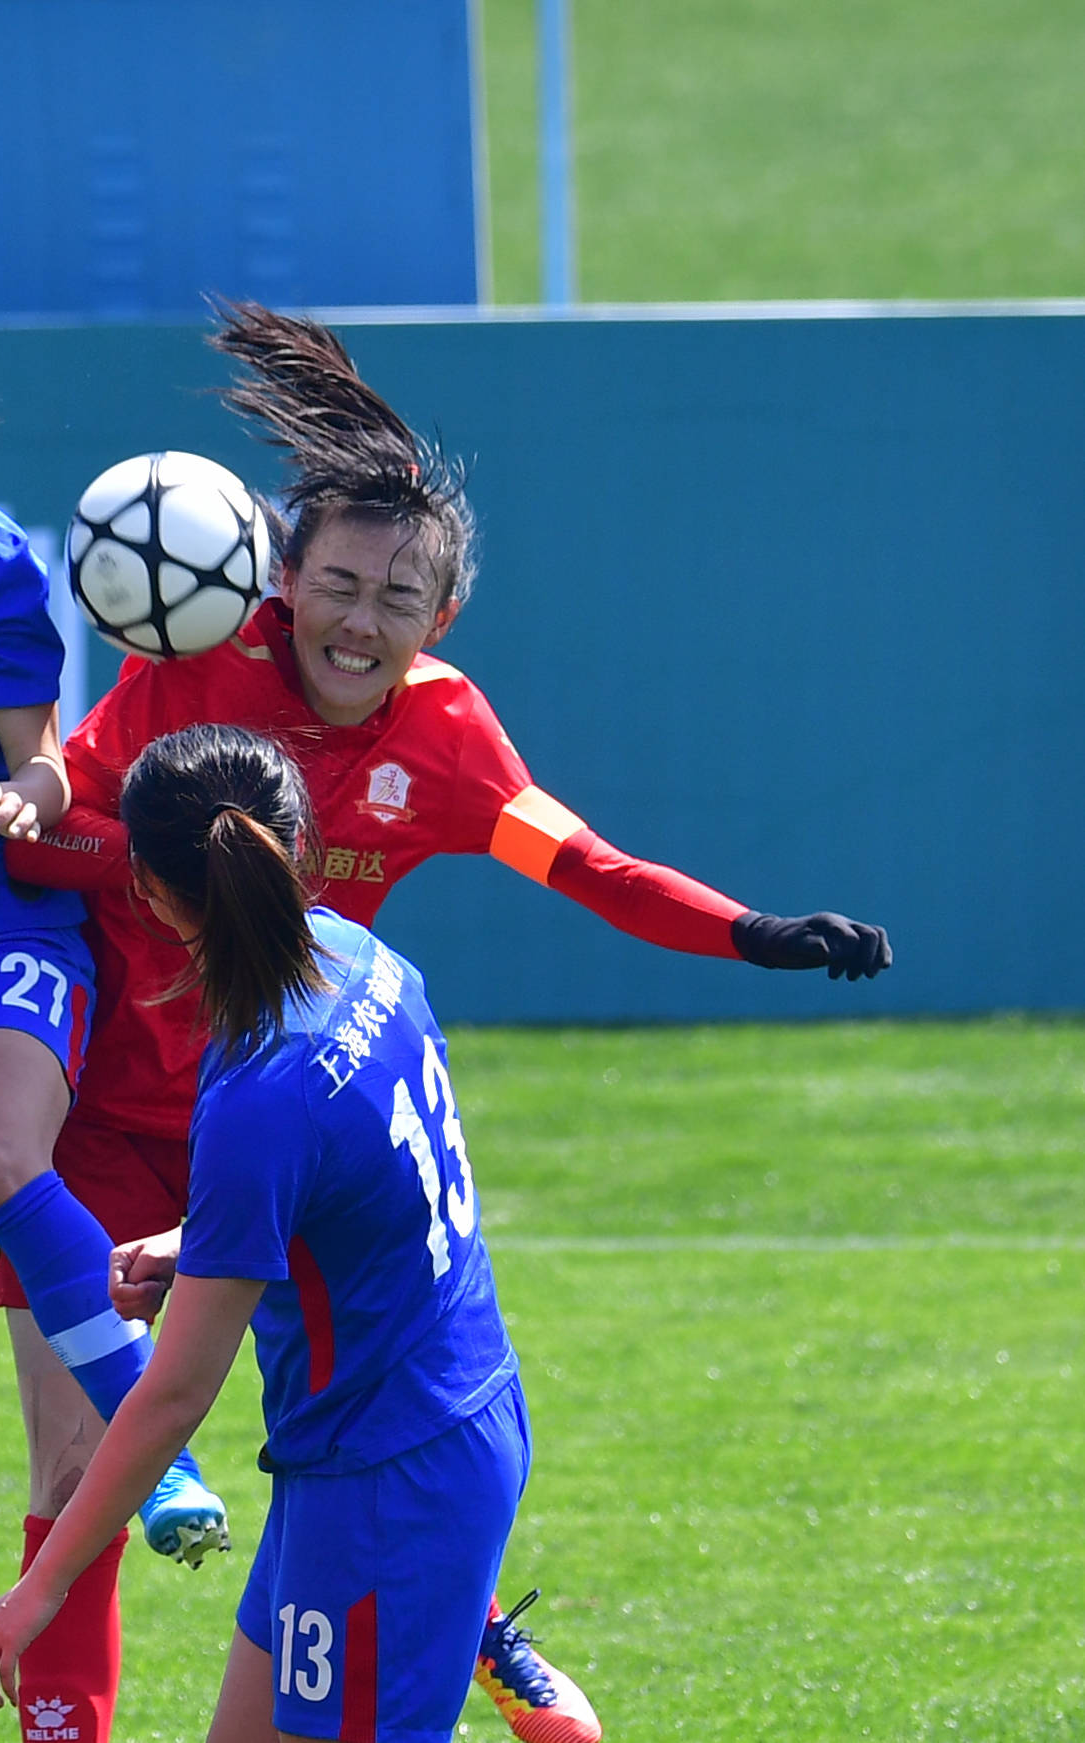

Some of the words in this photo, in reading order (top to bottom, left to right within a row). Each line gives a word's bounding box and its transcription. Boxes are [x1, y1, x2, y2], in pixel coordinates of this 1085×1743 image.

[0, 951, 68, 1028] 27
[389, 1034, 475, 1281] 13
[278, 1602, 333, 1702] 13
[26, 1727, 79, 1740] KELME
